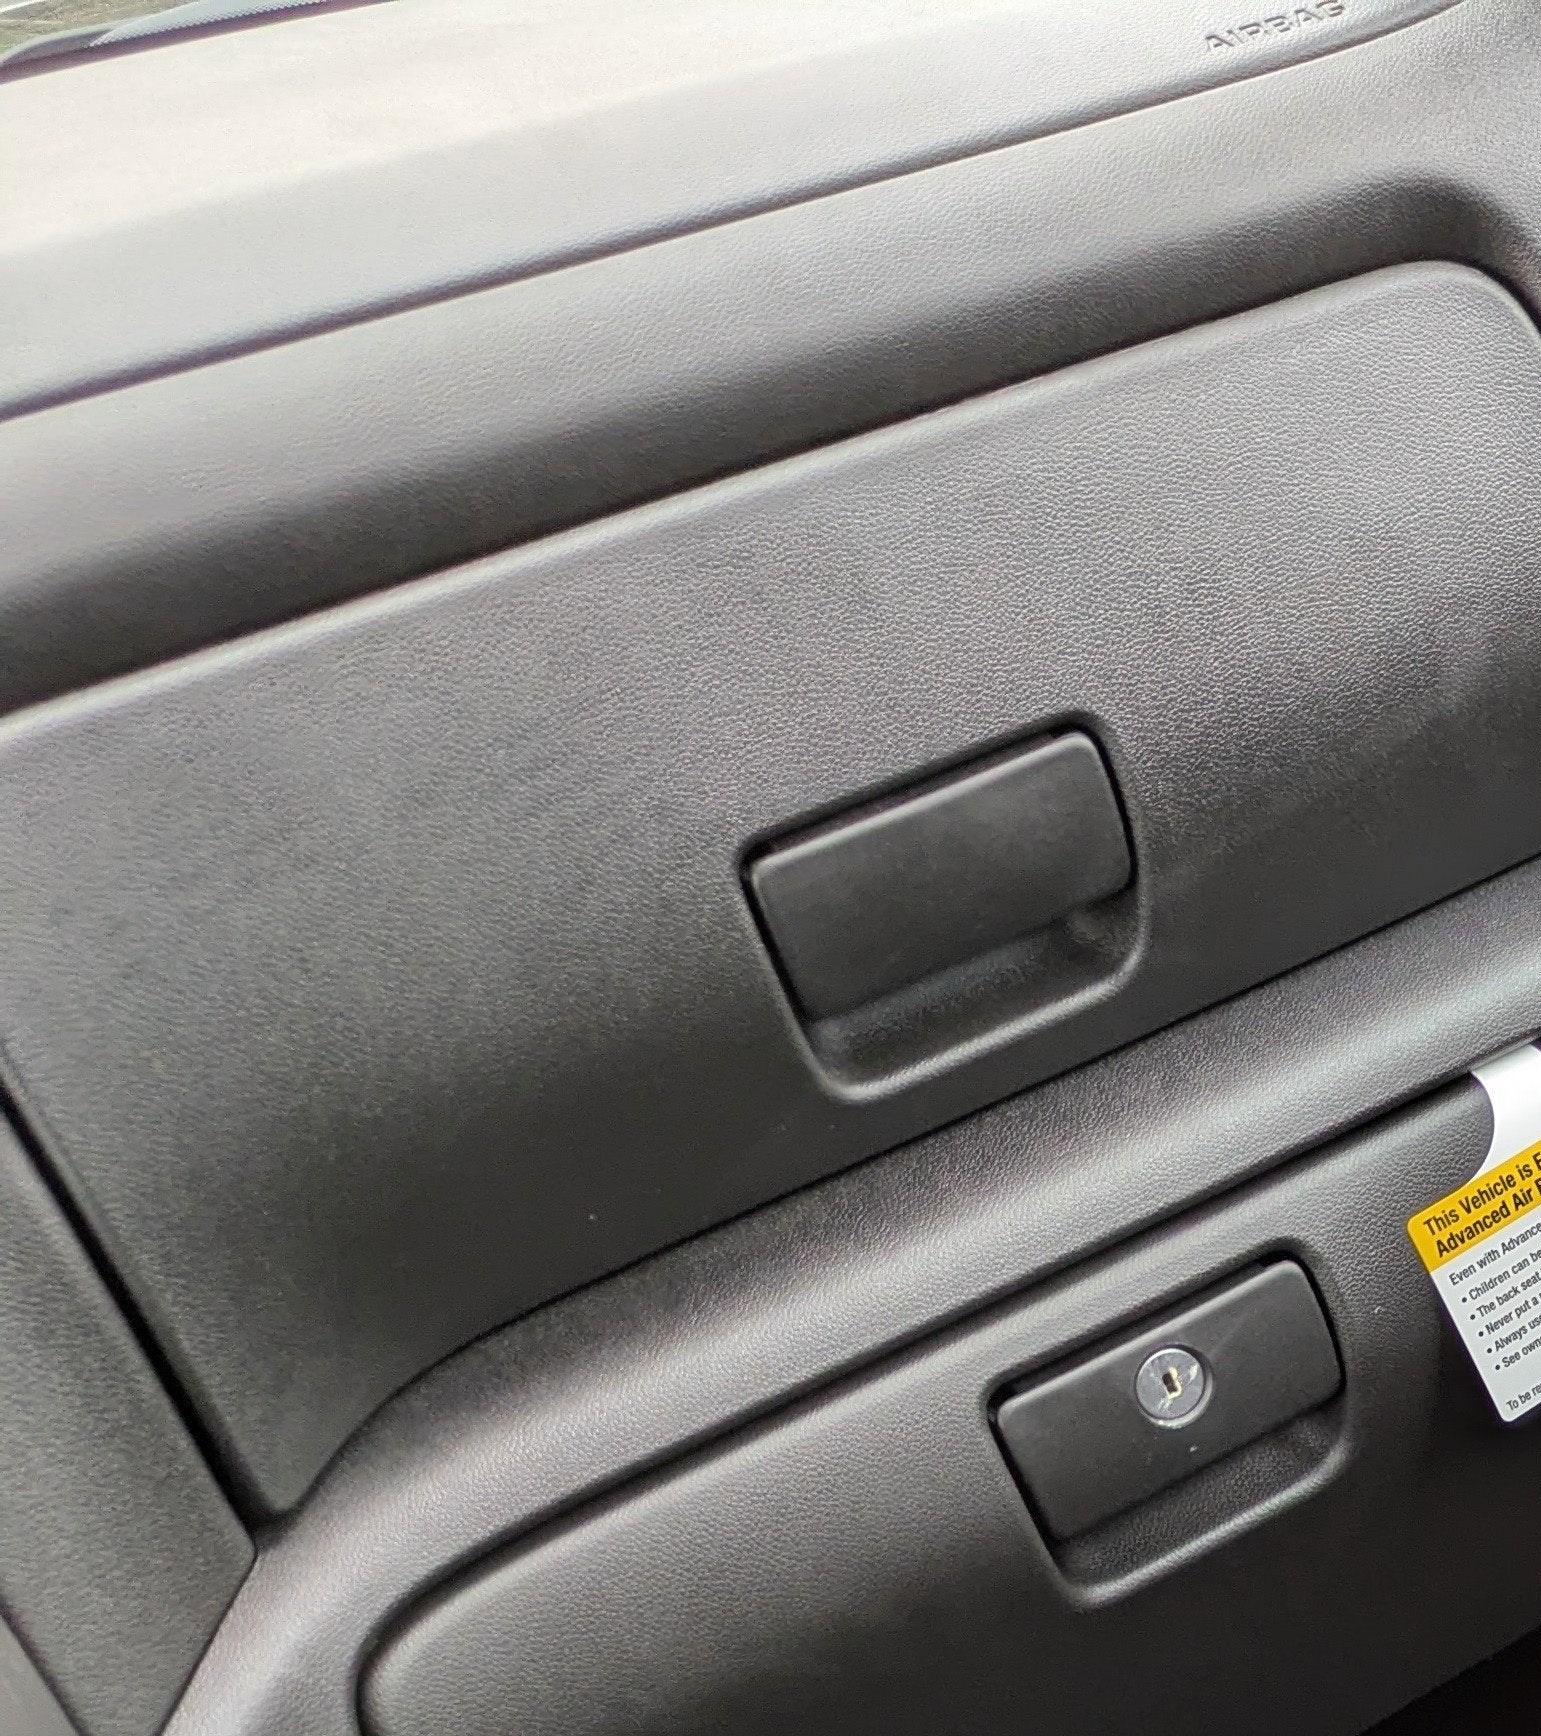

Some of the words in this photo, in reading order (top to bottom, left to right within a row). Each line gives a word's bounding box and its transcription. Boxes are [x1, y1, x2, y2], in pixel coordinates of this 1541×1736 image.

[1205, 0, 1346, 50] AIRBAG
[1422, 1208, 1460, 1236] This
[1457, 1173, 1517, 1215] Vehicle
[1515, 1163, 1534, 1182] is
[1435, 1199, 1512, 1259] Advanced
[1511, 1187, 1534, 1212] Air
[1448, 1264, 1477, 1287] Even
[1476, 1249, 1501, 1270] with
[1468, 1270, 1511, 1301] Children
[1510, 1257, 1531, 1275] can
[1475, 1301, 1497, 1318] The
[1495, 1285, 1522, 1307] back
[1484, 1311, 1514, 1336] Never
[1514, 1299, 1532, 1319] put
[1530, 1296, 1540, 1307] a
[1494, 1325, 1529, 1353] Always
[1501, 1351, 1522, 1368] See
[1505, 1399, 1520, 1411] To
[1517, 1391, 1532, 1405] be
